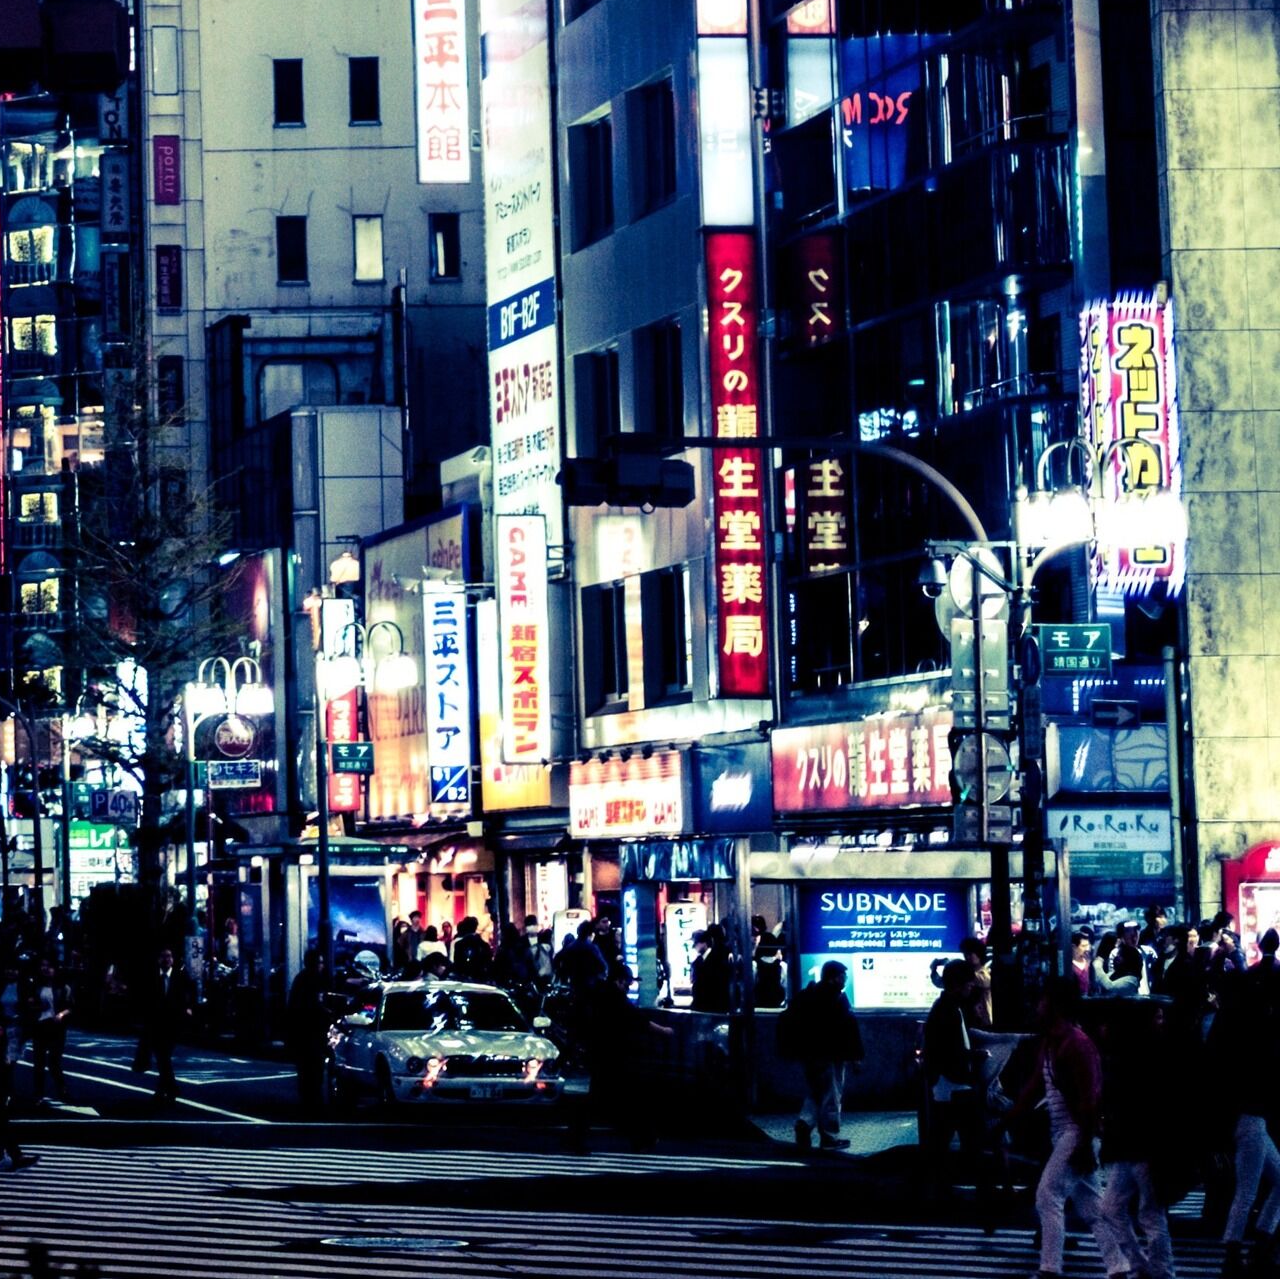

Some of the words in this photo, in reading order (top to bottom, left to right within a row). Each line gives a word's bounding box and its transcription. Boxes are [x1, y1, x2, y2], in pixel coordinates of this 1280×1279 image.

[716, 267, 764, 658] クスリの龍生堂薬局
[507, 526, 528, 609] GAME
[1051, 631, 1102, 648] モア
[432, 600, 461, 751] 三平ストア
[337, 745, 370, 757] モア
[820, 892, 947, 914] SUBNADE
